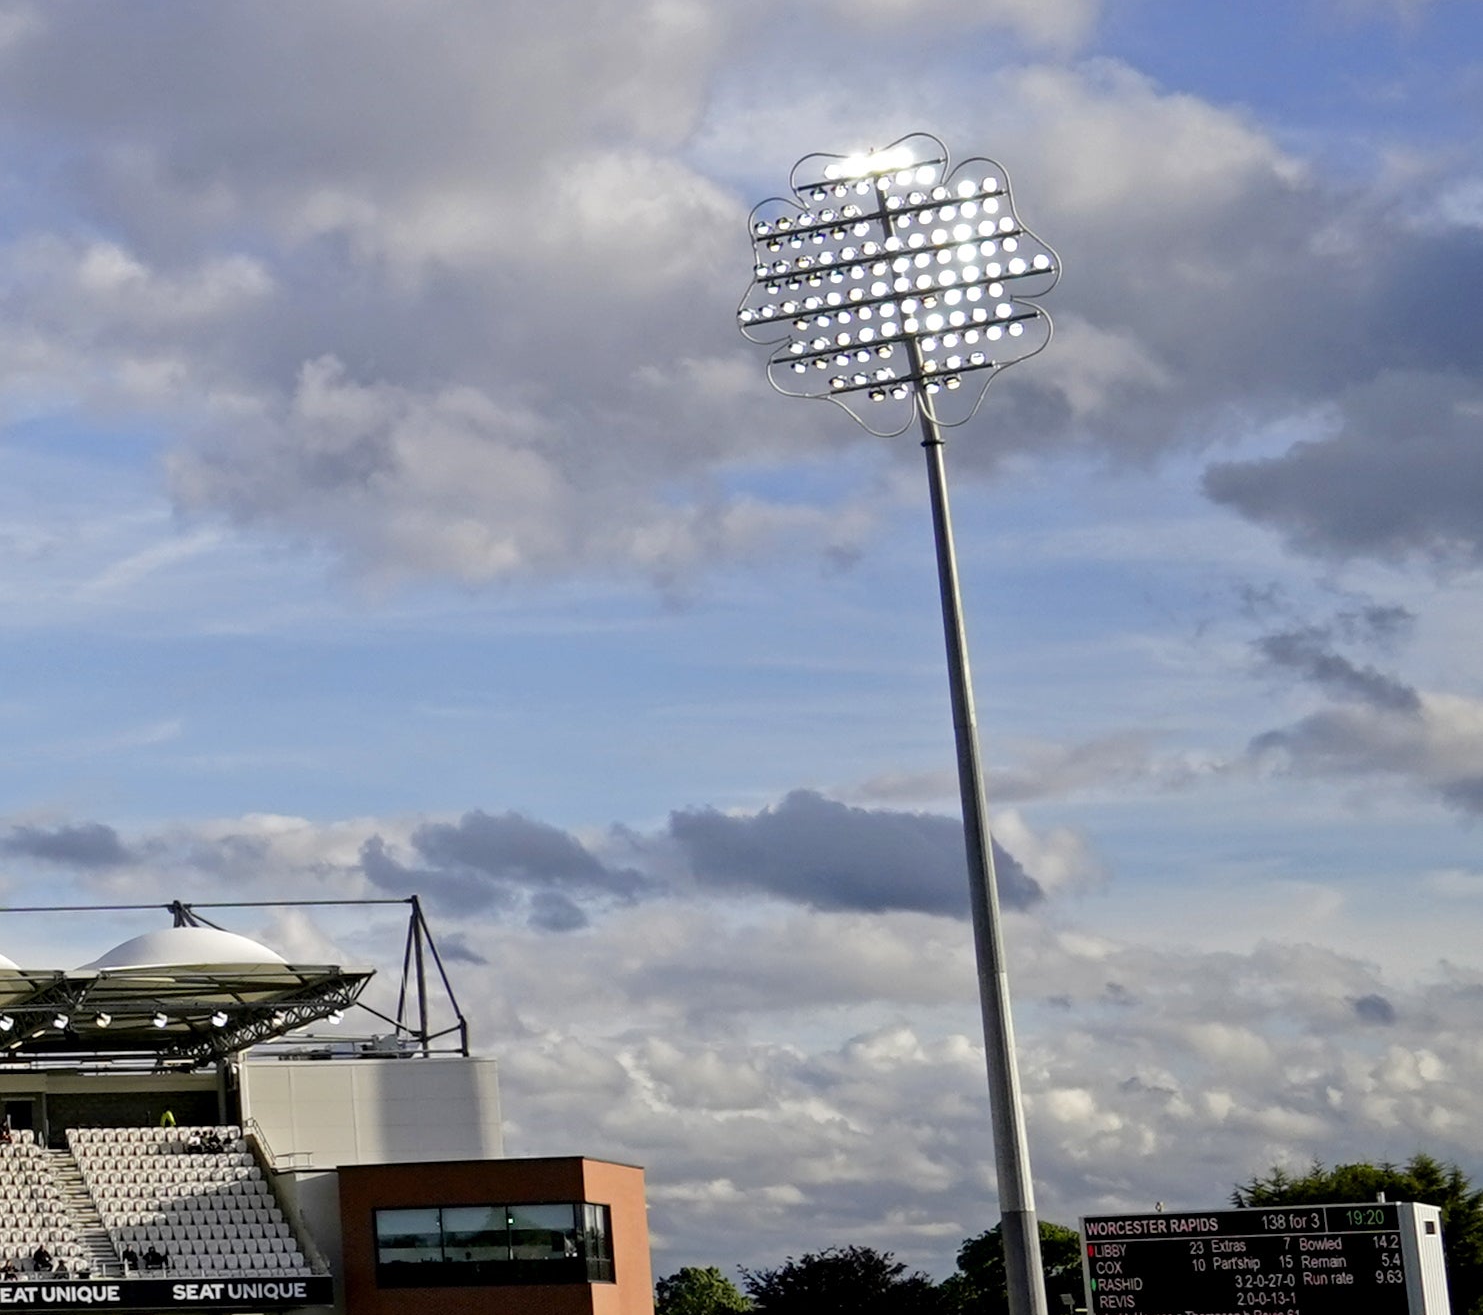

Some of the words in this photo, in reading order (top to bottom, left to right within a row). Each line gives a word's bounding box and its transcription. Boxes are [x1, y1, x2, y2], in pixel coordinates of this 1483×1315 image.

[1261, 1215, 1286, 1229] 138
[1290, 1214, 1307, 1228] for
[1311, 1213, 1320, 1228] 3
[1346, 1209, 1384, 1225] 19:20
[1086, 1219, 1167, 1236] WORCESTER
[1170, 1218, 1218, 1232] RAPIDS
[1095, 1244, 1126, 1258] LIBBY
[1190, 1241, 1204, 1254] 23
[1211, 1240, 1246, 1253] Extras
[1284, 1237, 1290, 1250] 7
[1299, 1237, 1342, 1250] Bowled
[1373, 1235, 1399, 1249] 14.2
[1096, 1261, 1123, 1274] COX
[1193, 1259, 1205, 1271] 10
[1279, 1255, 1293, 1268] 15
[1301, 1255, 1347, 1268] Remain
[1382, 1253, 1401, 1267] 5.4
[1098, 1278, 1143, 1291] RASHID
[1303, 1272, 1328, 1285] Run
[1331, 1272, 1354, 1284] rate
[1375, 1270, 1403, 1283] 9.63
[173, 1284, 224, 1300] SEAT
[228, 1283, 307, 1300] UNIQUE
[1100, 1295, 1135, 1308] REVIS
